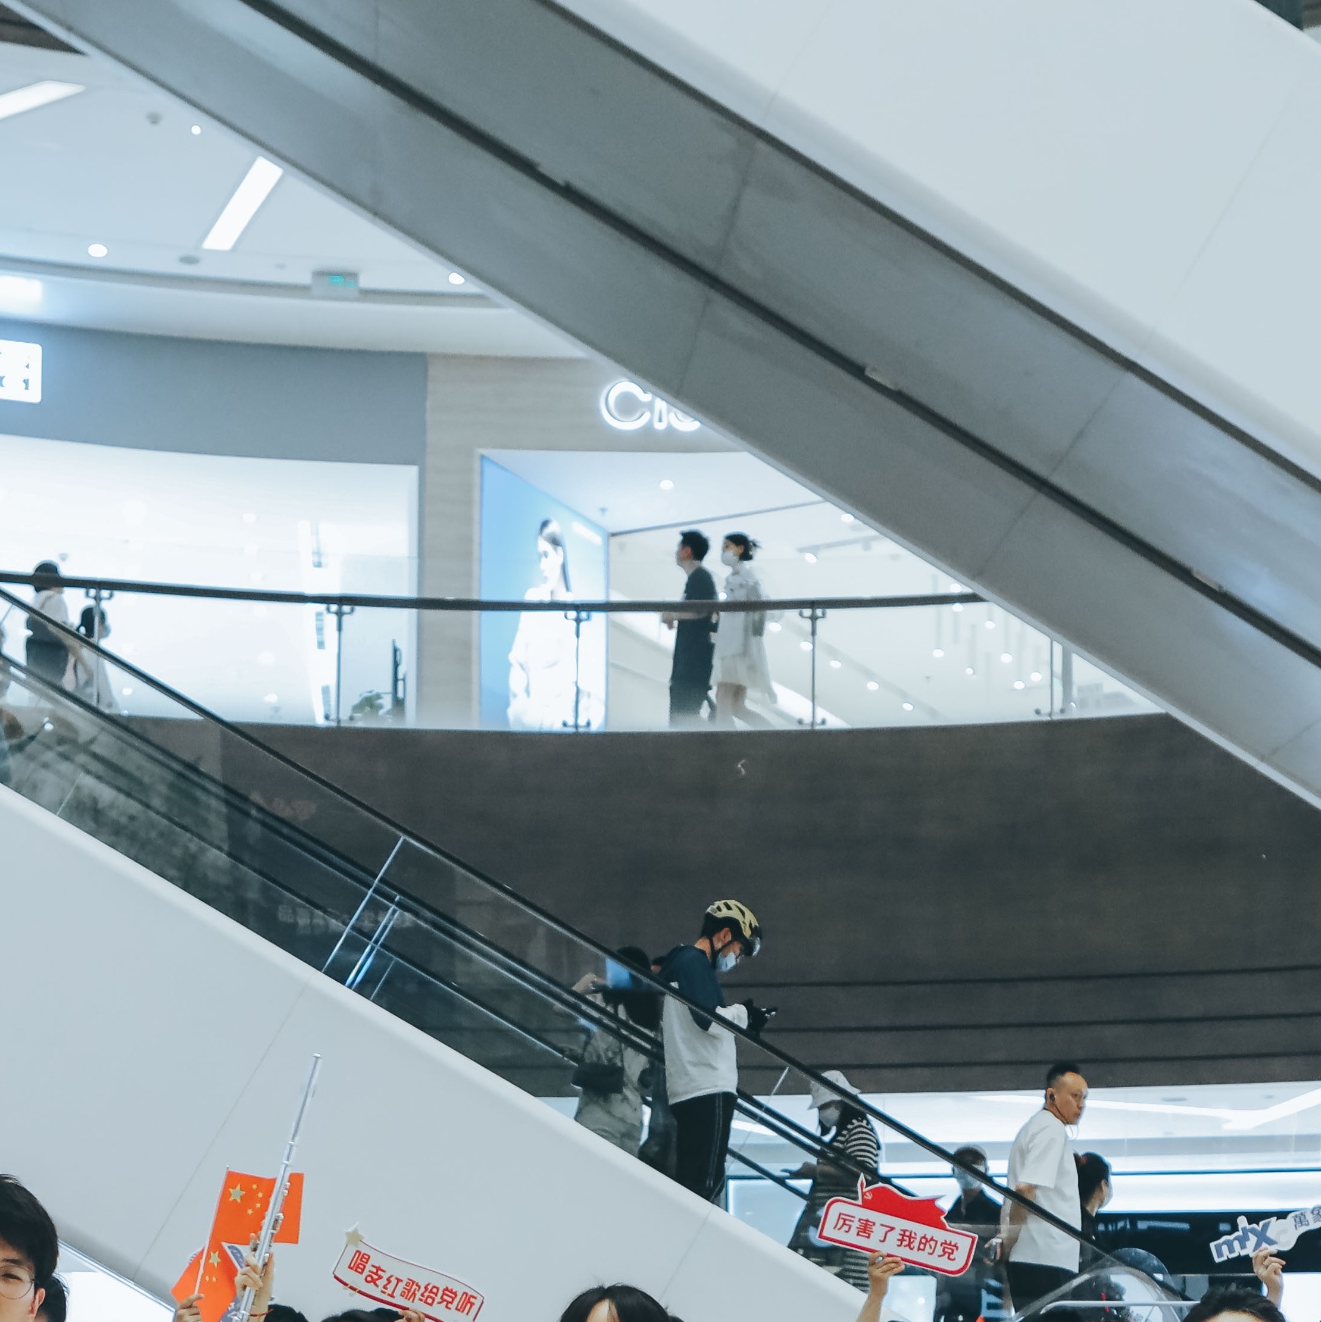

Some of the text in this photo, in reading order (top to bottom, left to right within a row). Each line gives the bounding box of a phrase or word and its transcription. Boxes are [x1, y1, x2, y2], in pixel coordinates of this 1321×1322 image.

[833, 1211, 960, 1262] 厉害了我的党
[347, 1249, 478, 1316] 唱支红歌给党听
